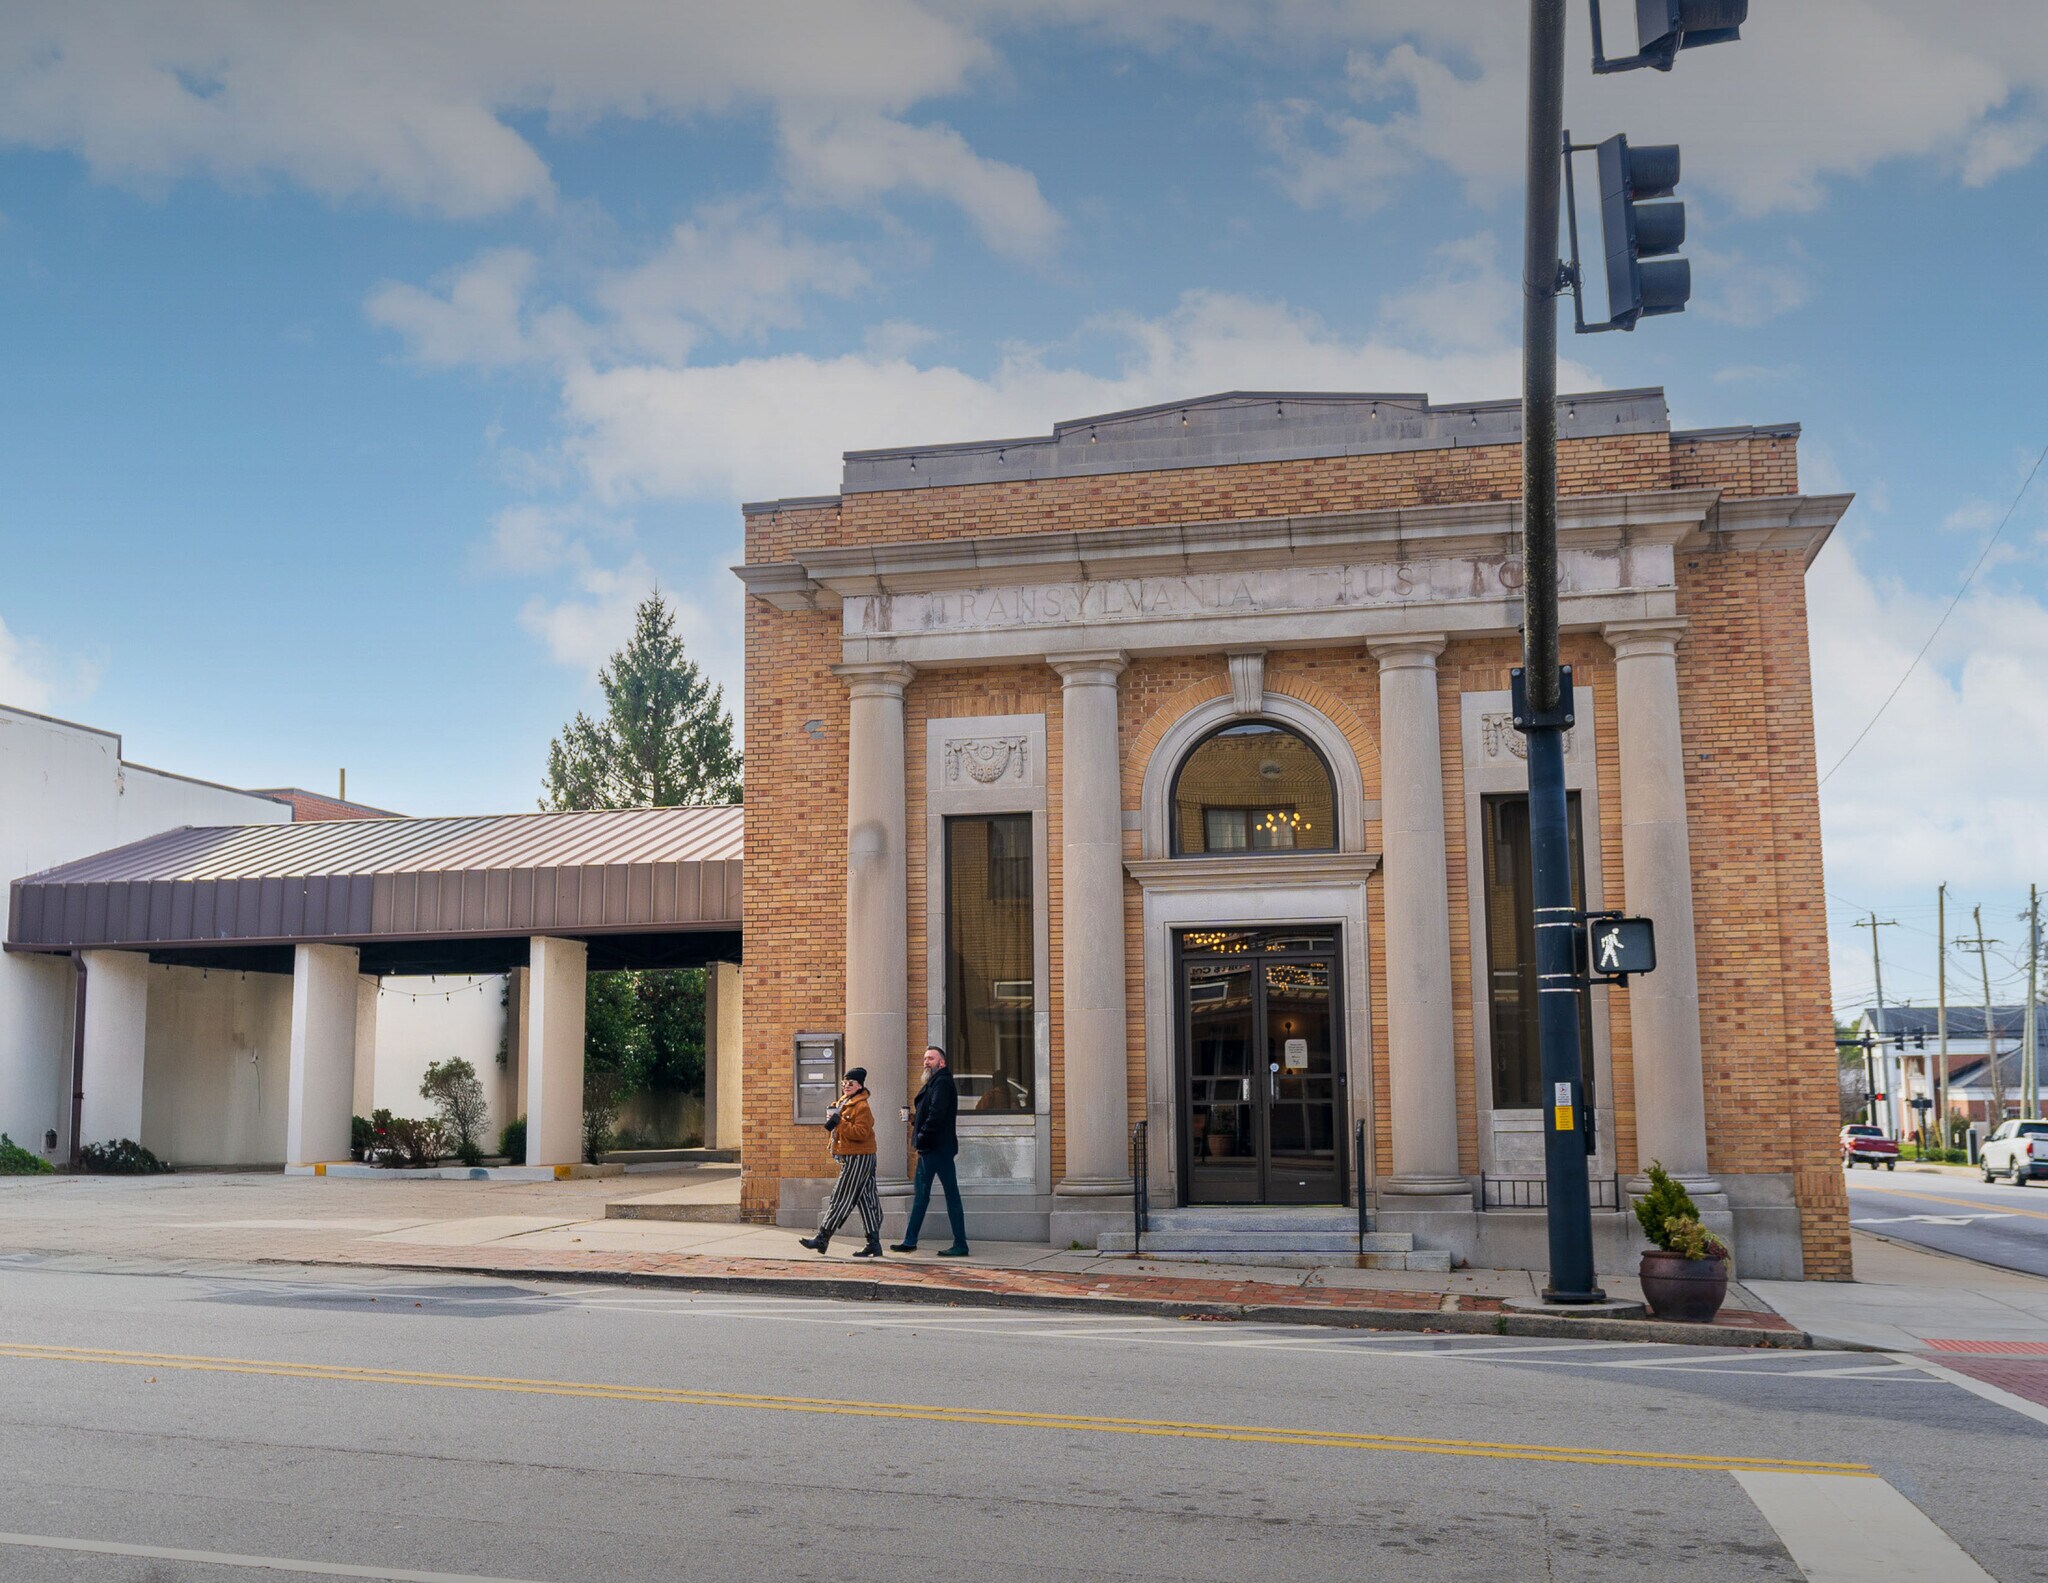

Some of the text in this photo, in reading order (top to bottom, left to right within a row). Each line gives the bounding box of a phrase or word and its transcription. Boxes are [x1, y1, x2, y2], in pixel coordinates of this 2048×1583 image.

[935, 559, 1566, 624] TRANSYLVANIA TRUST C
